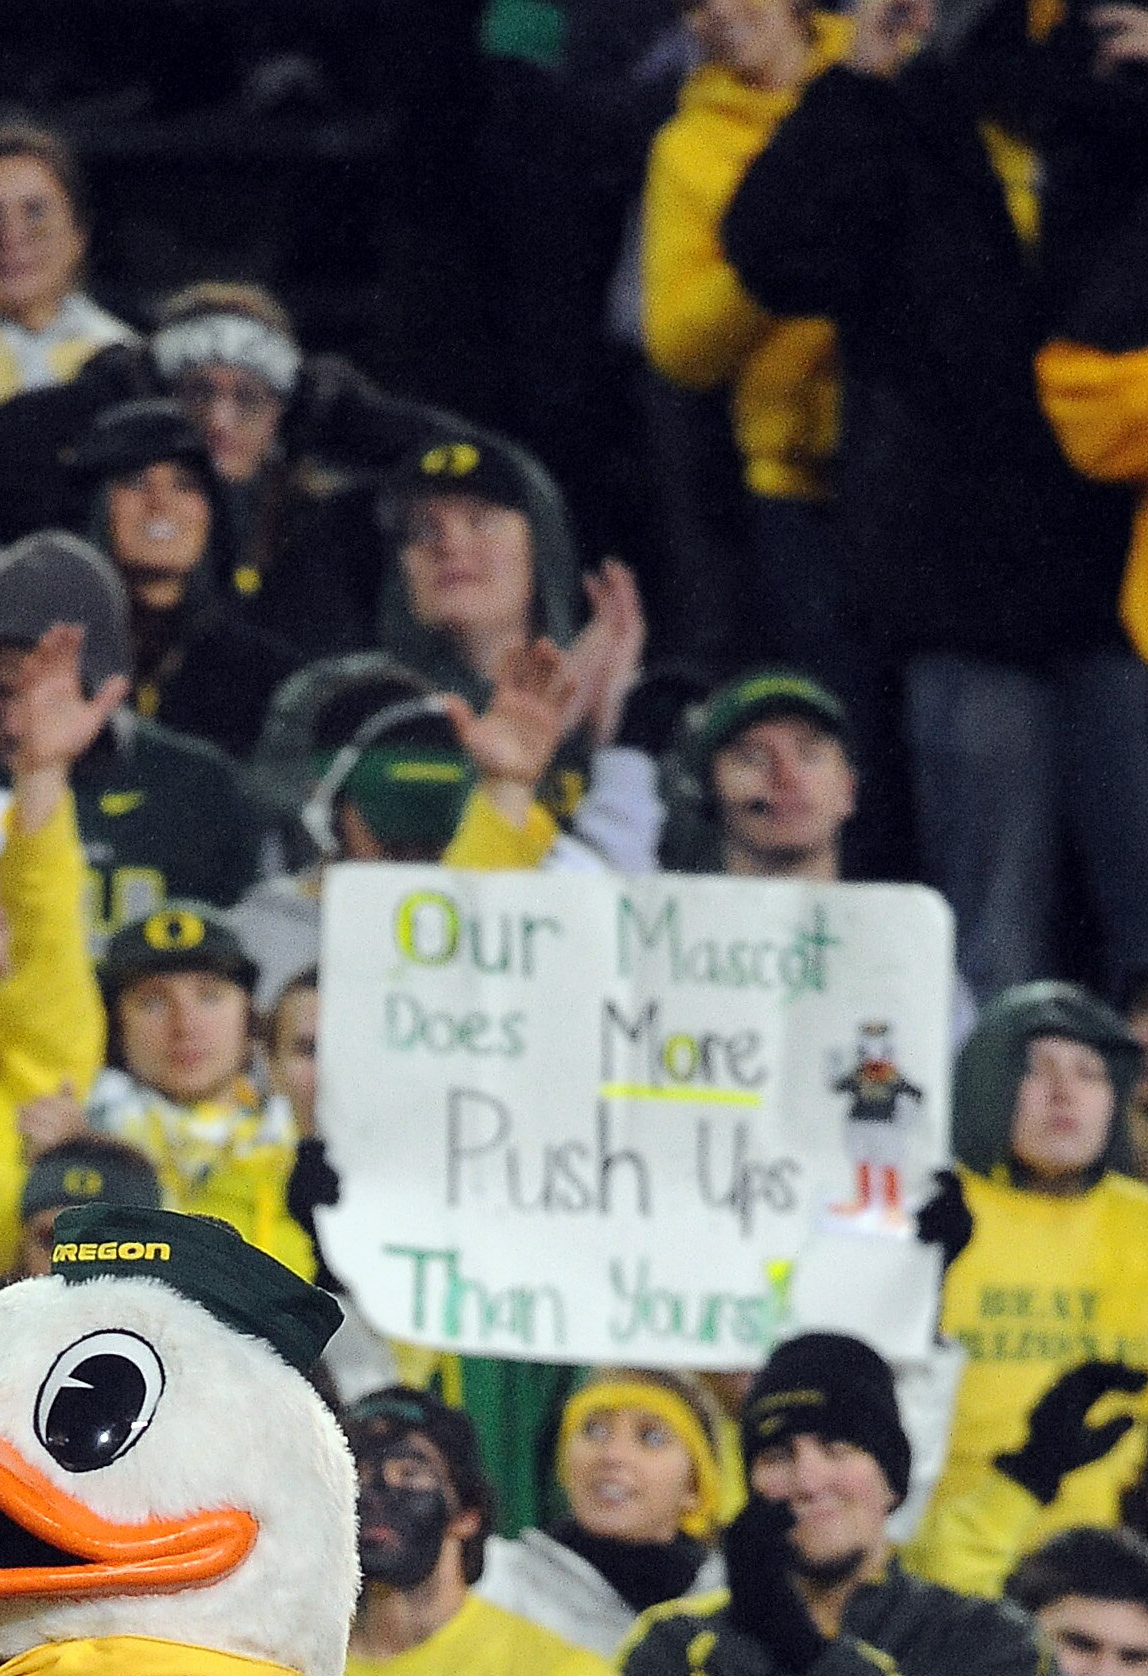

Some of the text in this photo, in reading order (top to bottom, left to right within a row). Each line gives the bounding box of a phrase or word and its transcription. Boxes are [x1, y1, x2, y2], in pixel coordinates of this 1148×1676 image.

[395, 890, 839, 997] Our Mascot
[384, 992, 768, 1086] Does More
[446, 1086, 804, 1237] Push Ups
[382, 1242, 567, 1344] Than
